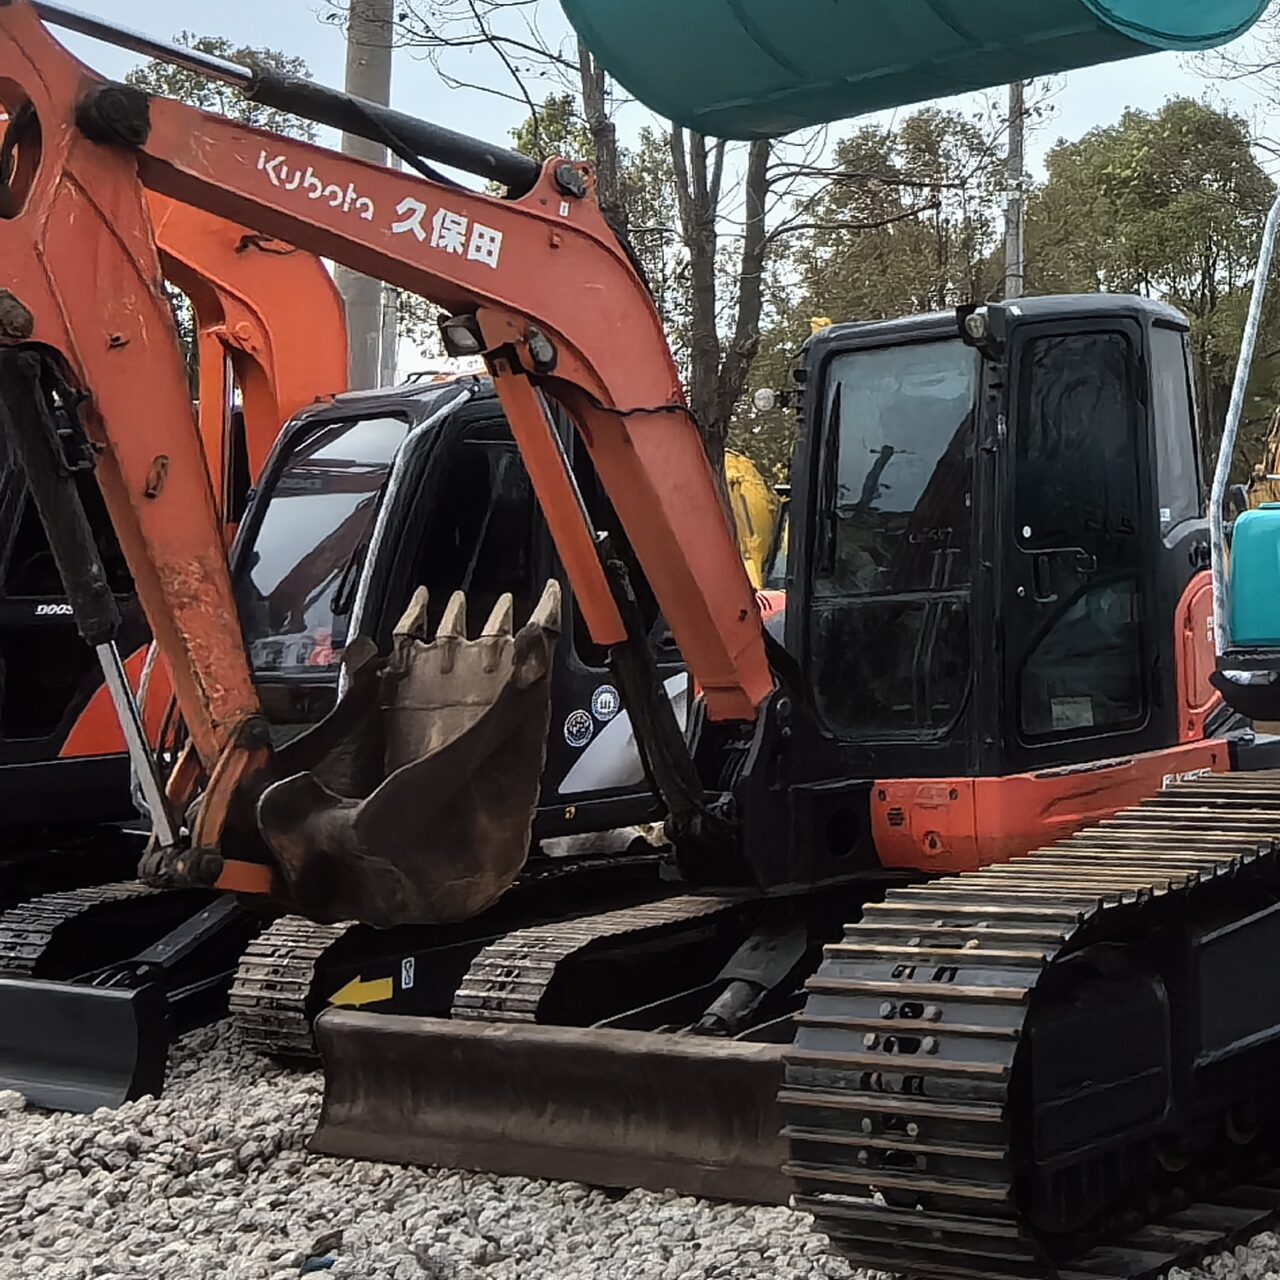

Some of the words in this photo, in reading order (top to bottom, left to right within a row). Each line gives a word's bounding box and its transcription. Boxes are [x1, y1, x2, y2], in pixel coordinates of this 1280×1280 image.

[257, 150, 374, 221] Kubota
[392, 197, 503, 269] 久保田
